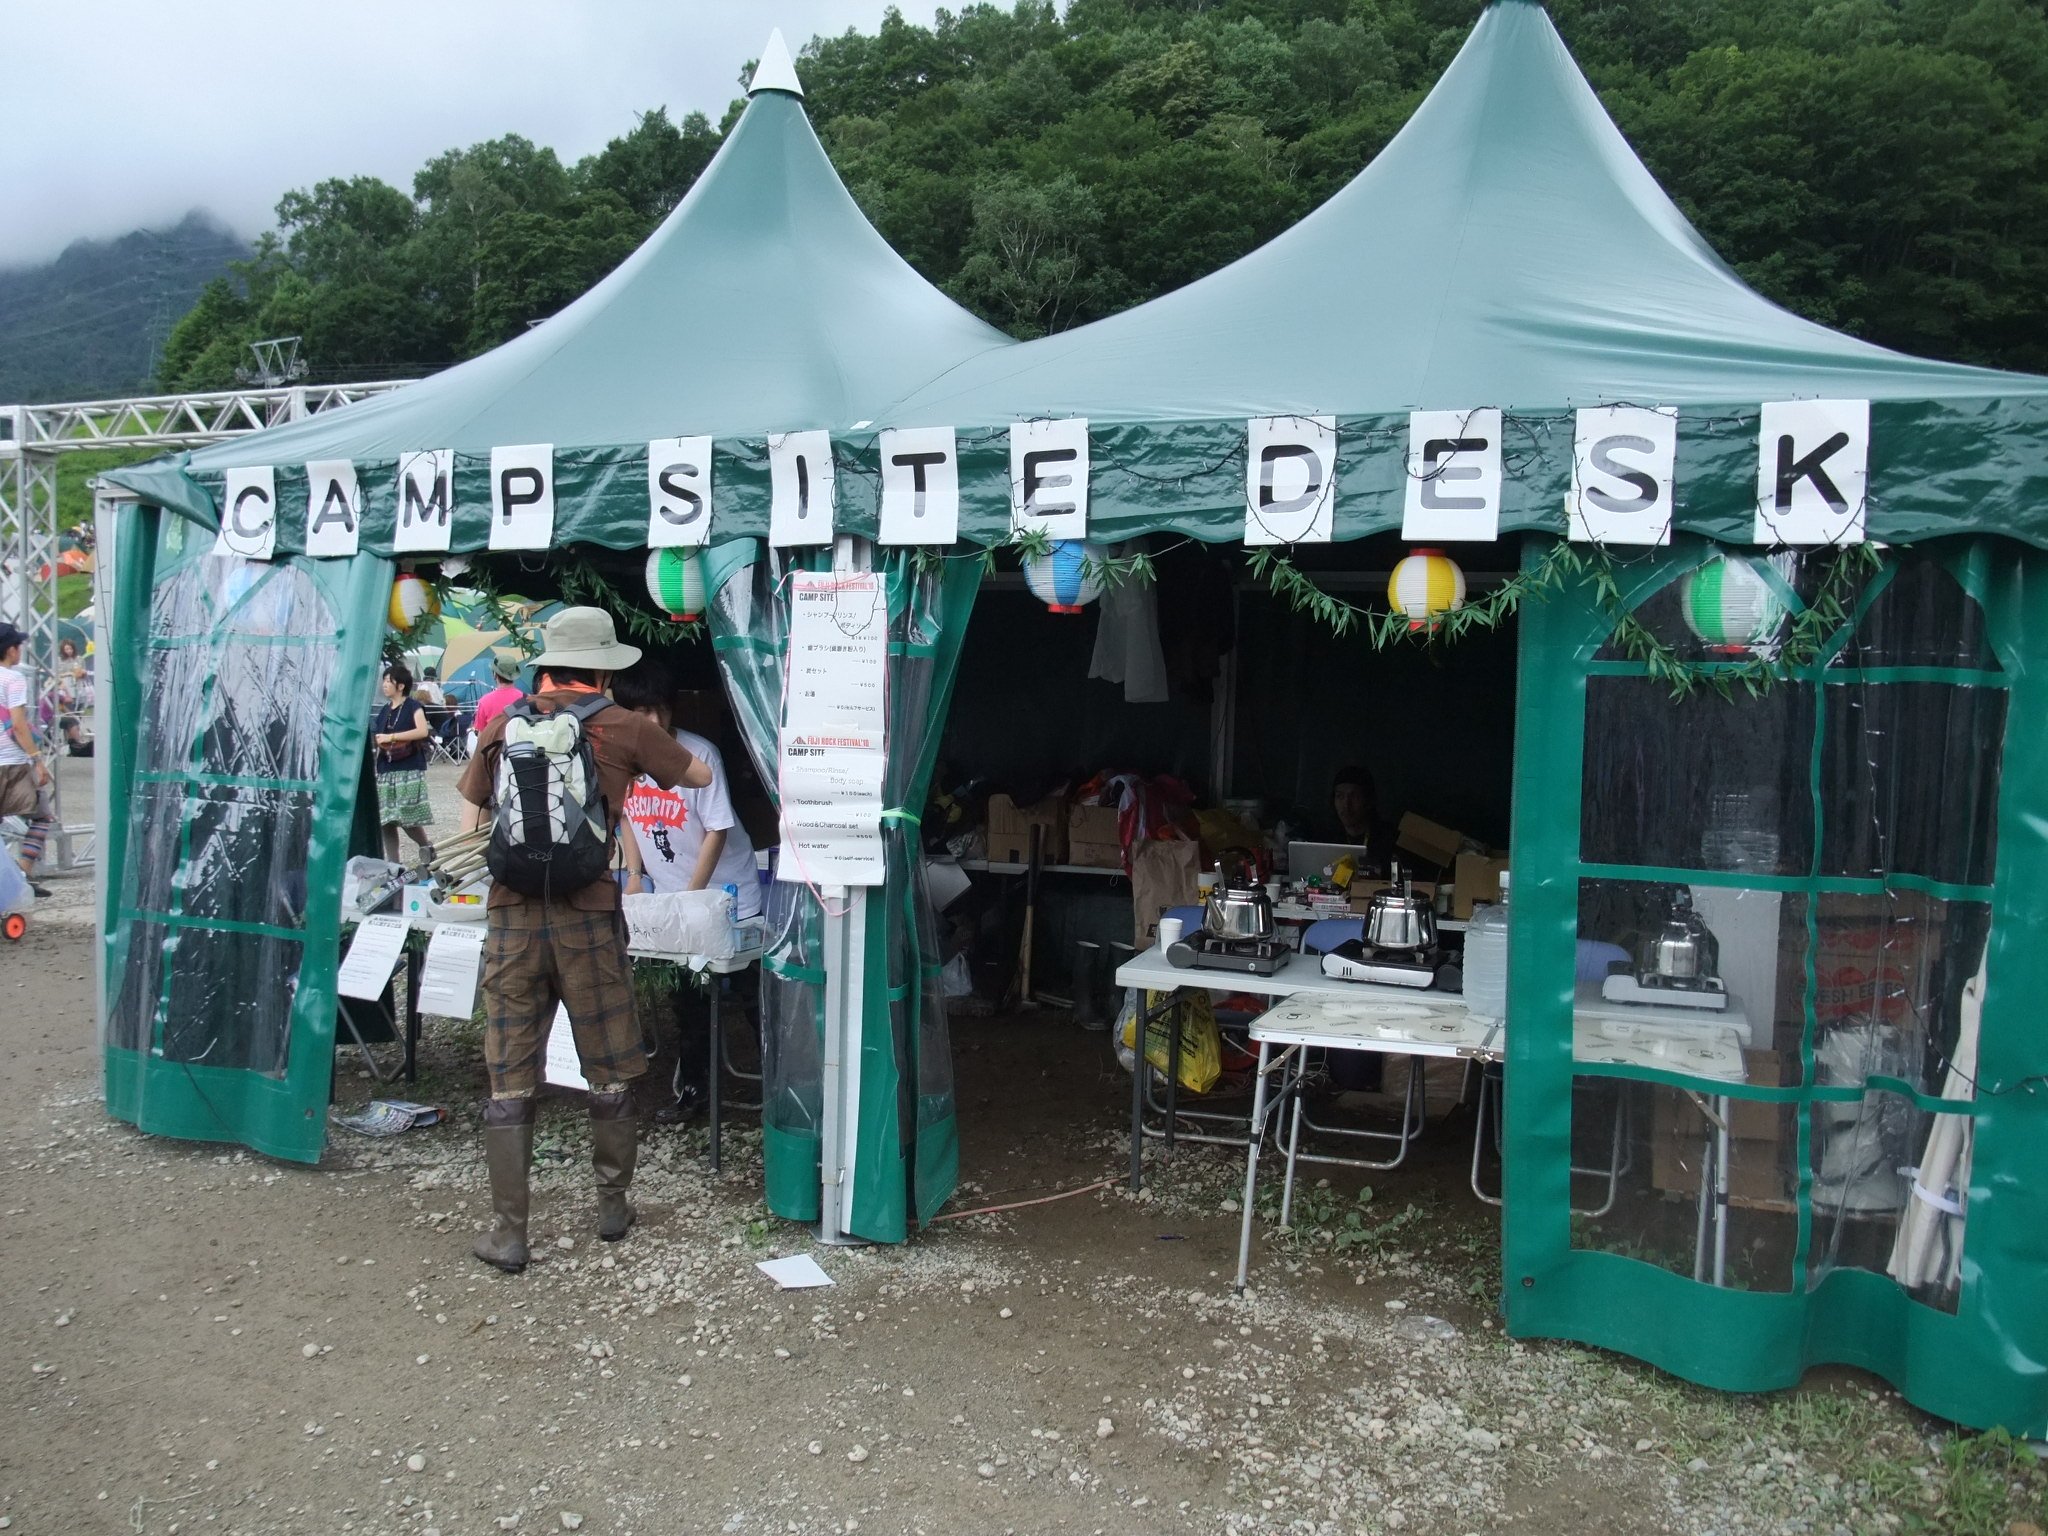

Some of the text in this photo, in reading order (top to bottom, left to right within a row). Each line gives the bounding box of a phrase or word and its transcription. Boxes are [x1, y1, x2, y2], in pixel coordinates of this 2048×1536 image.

[231, 431, 1852, 540] CAMP SITE DESK
[799, 593, 834, 602] CAMP SITE
[807, 736, 821, 745] FUJI
[822, 737, 836, 746] ROCK
[788, 747, 809, 756] CAMP
[830, 777, 846, 786] Body
[627, 796, 682, 820] SECURITY
